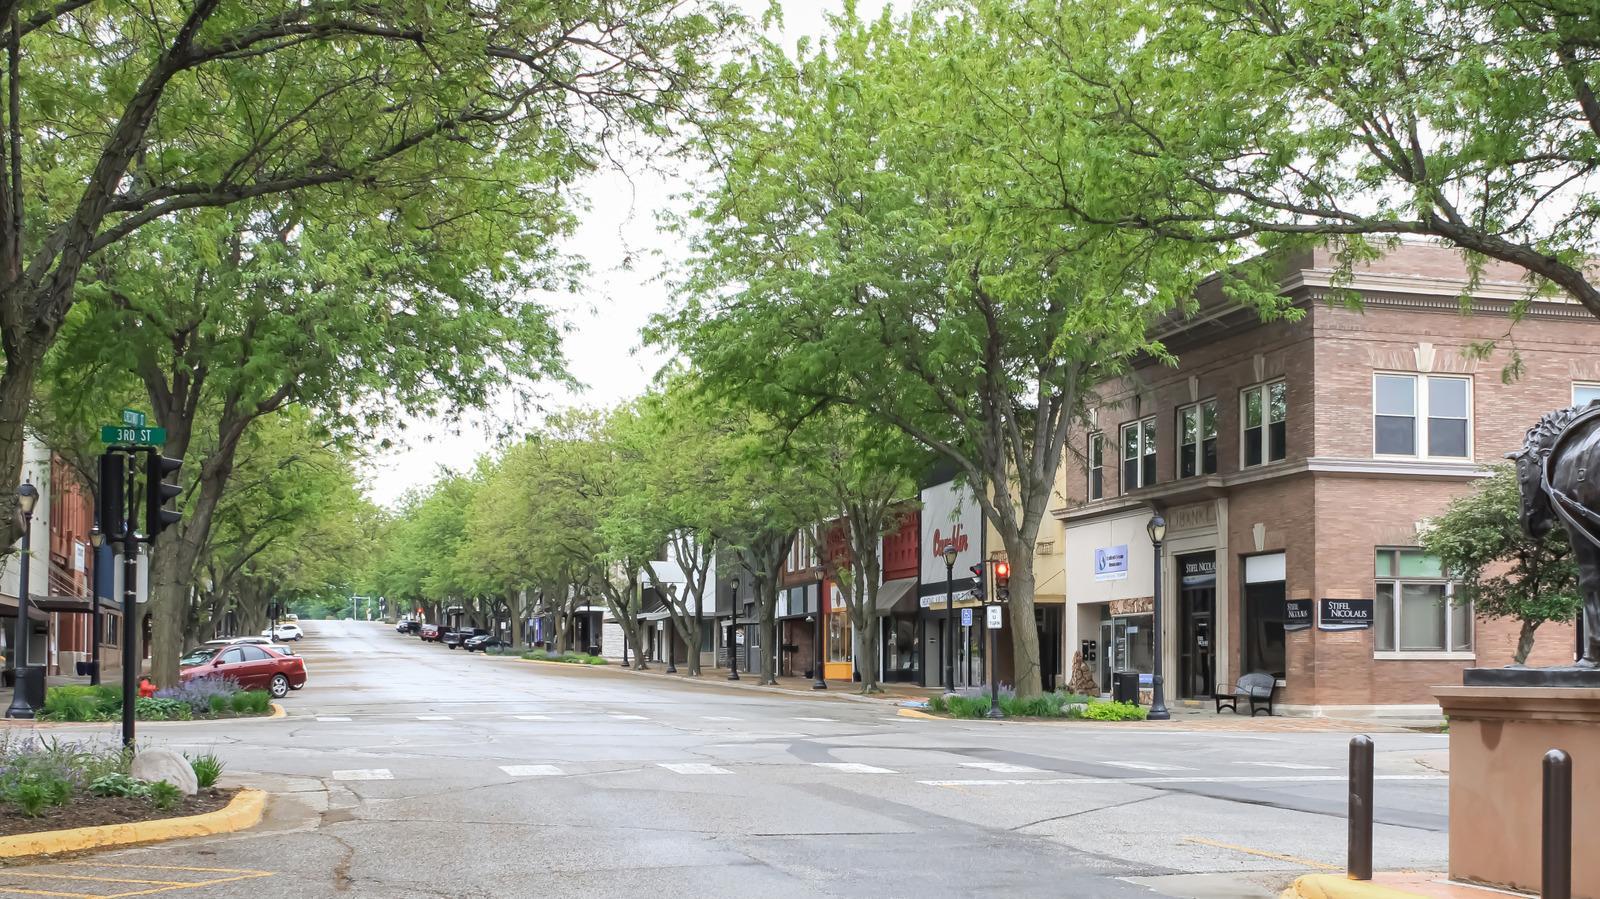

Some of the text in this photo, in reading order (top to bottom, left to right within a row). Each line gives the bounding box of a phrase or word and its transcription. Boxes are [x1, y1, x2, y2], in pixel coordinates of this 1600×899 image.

[117, 429, 151, 442] 3RD ST
[1186, 563, 1198, 573] STIFEL
[1287, 603, 1299, 611] STIFEL
[1328, 601, 1350, 610] STIFEL
[1288, 609, 1308, 618] NICOLAUS
[1331, 609, 1367, 618] NICOLAUS
